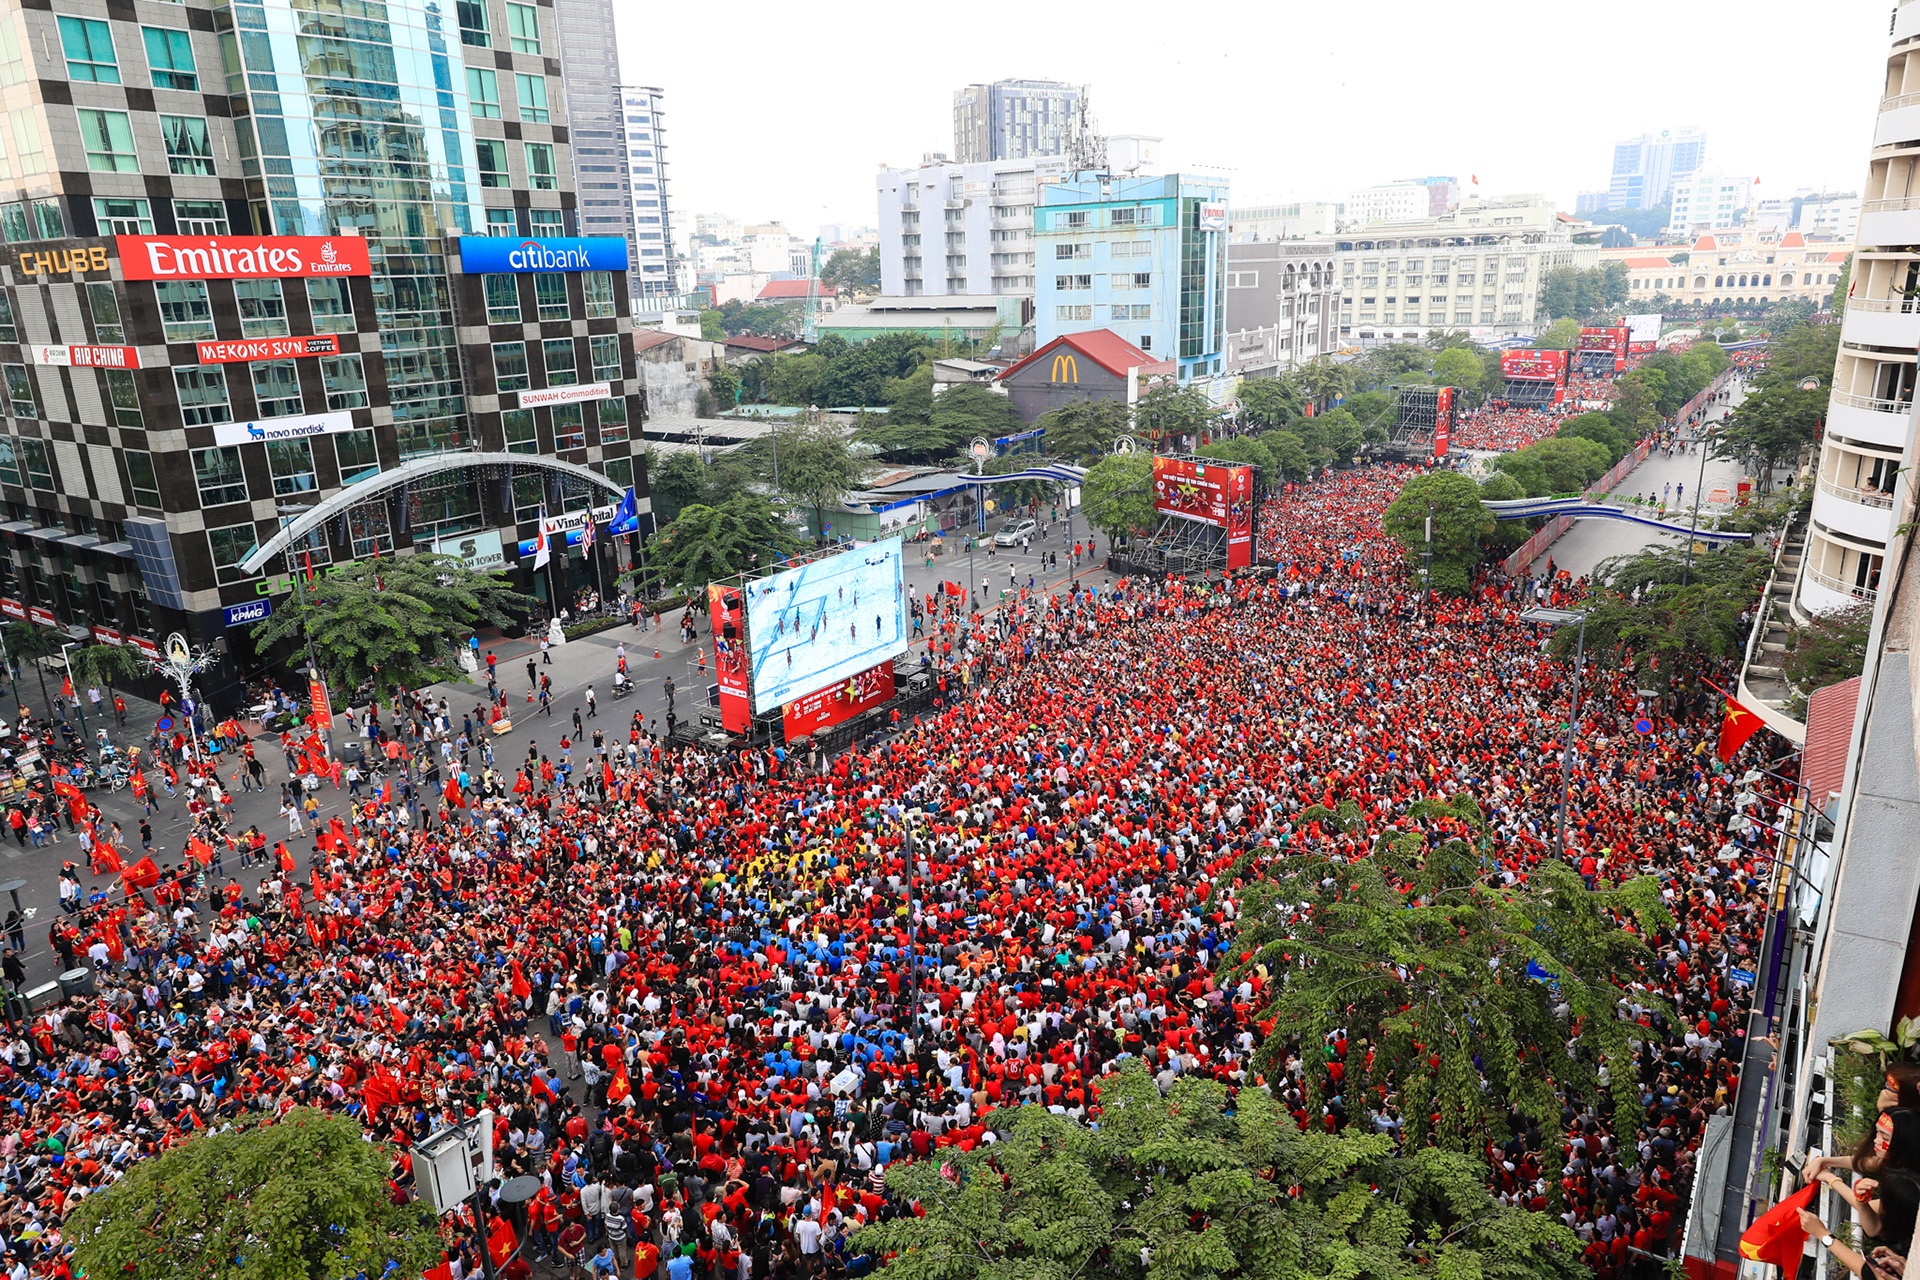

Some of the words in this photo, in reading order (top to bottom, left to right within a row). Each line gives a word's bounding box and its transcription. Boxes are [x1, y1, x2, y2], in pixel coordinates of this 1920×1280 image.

[19, 246, 110, 276] CHUBB
[145, 240, 302, 275] Emirates
[509, 243, 591, 269] citibank
[310, 261, 352, 273] Emirates
[74, 347, 92, 365] AIR
[92, 347, 126, 367] CHINA
[201, 342, 268, 360] MEKONG
[271, 341, 302, 356] SUN
[304, 344, 337, 353] COFFEE
[522, 391, 559, 404] SUNWAH
[560, 387, 609, 400] Commodities
[266, 429, 290, 439] novo
[291, 423, 325, 436] nordisk
[556, 507, 614, 529] VinaCpital
[476, 553, 502, 566] TOWER
[231, 604, 264, 623] KPMG
